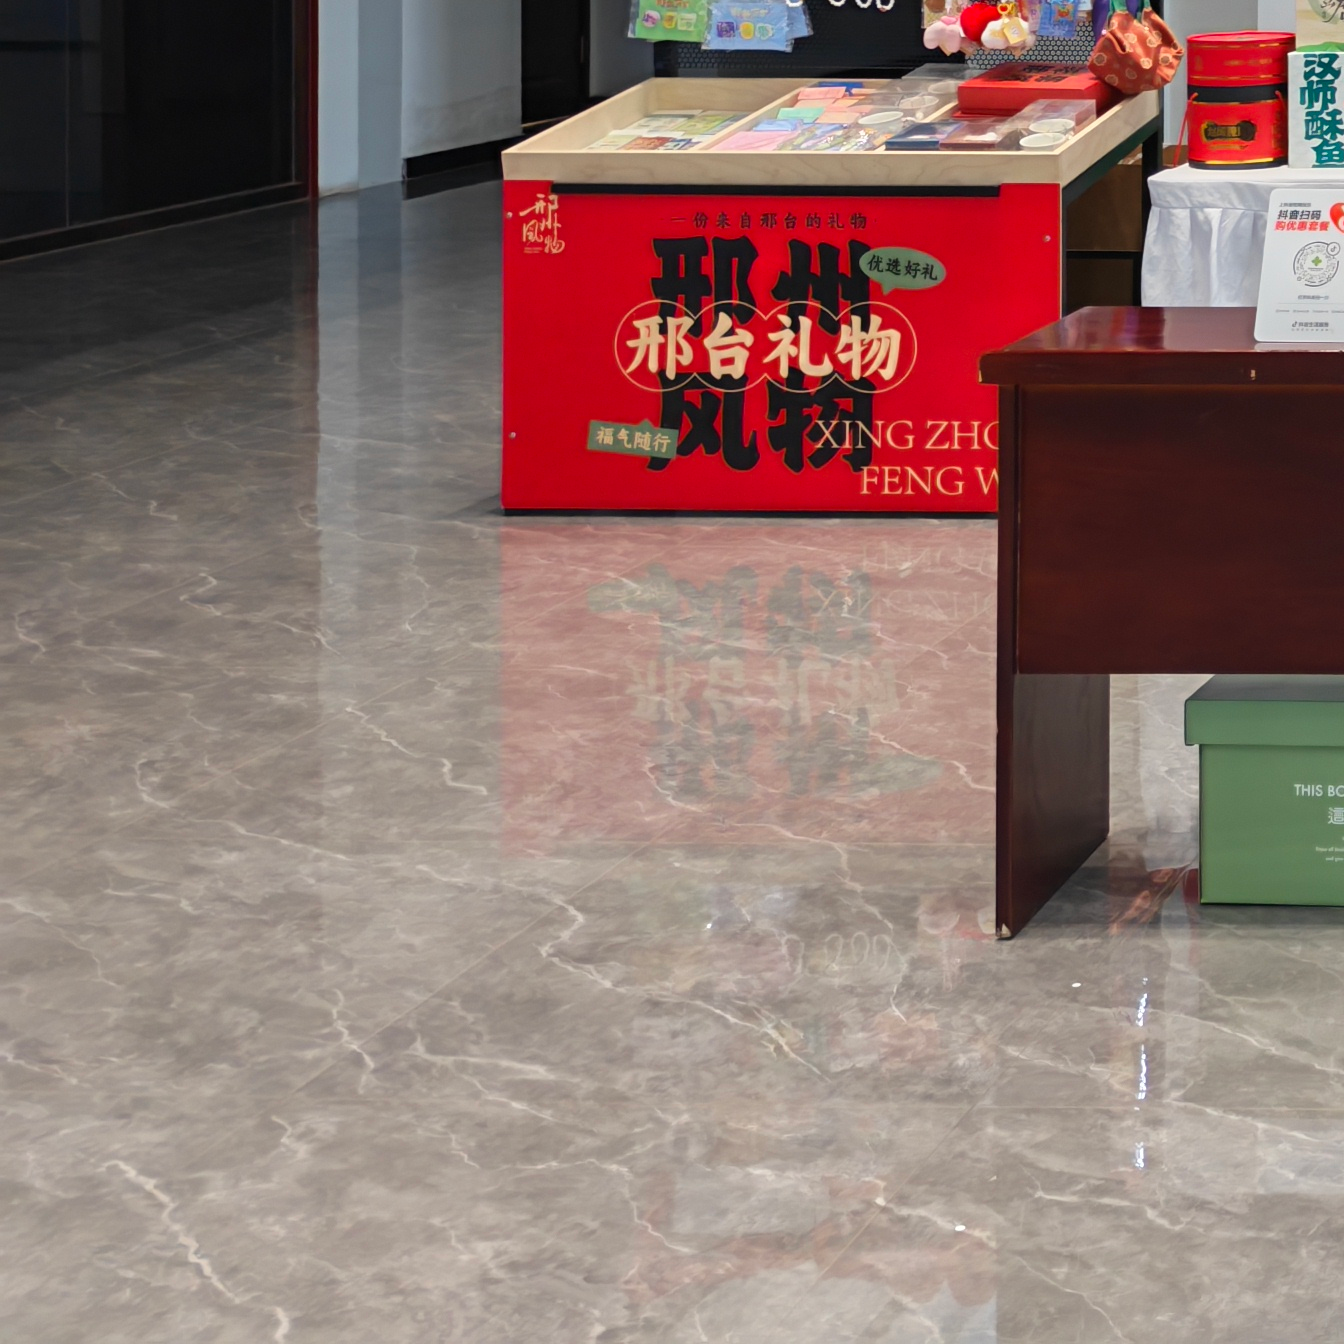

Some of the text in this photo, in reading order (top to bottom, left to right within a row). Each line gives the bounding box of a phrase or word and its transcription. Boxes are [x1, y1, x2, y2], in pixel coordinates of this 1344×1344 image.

[671, 212, 868, 231] 一份来自邢台的礼物
[1277, 210, 1322, 220] 抖音扫码
[866, 254, 939, 282] 优选好礼
[625, 312, 900, 382] 邢台礼物
[595, 426, 672, 453] 福气随行
[813, 420, 914, 450] XING
[860, 466, 964, 496] FENG
[1294, 784, 1323, 797] THIS
